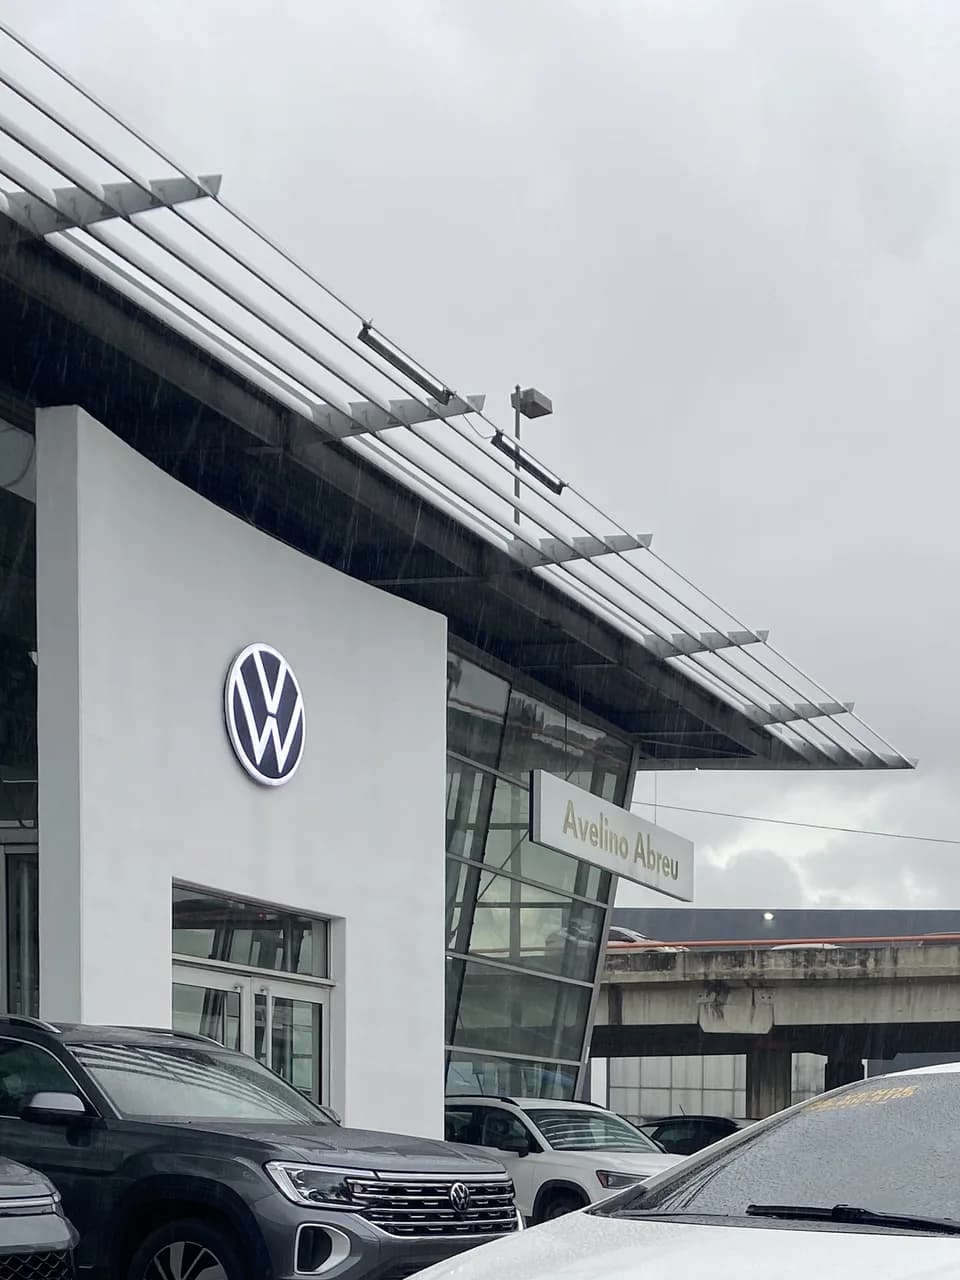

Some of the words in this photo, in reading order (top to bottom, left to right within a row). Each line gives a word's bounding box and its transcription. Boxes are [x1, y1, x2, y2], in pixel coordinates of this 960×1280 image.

[229, 647, 305, 779] VW
[562, 799, 629, 860] Avelino
[633, 831, 680, 881] Abreu
